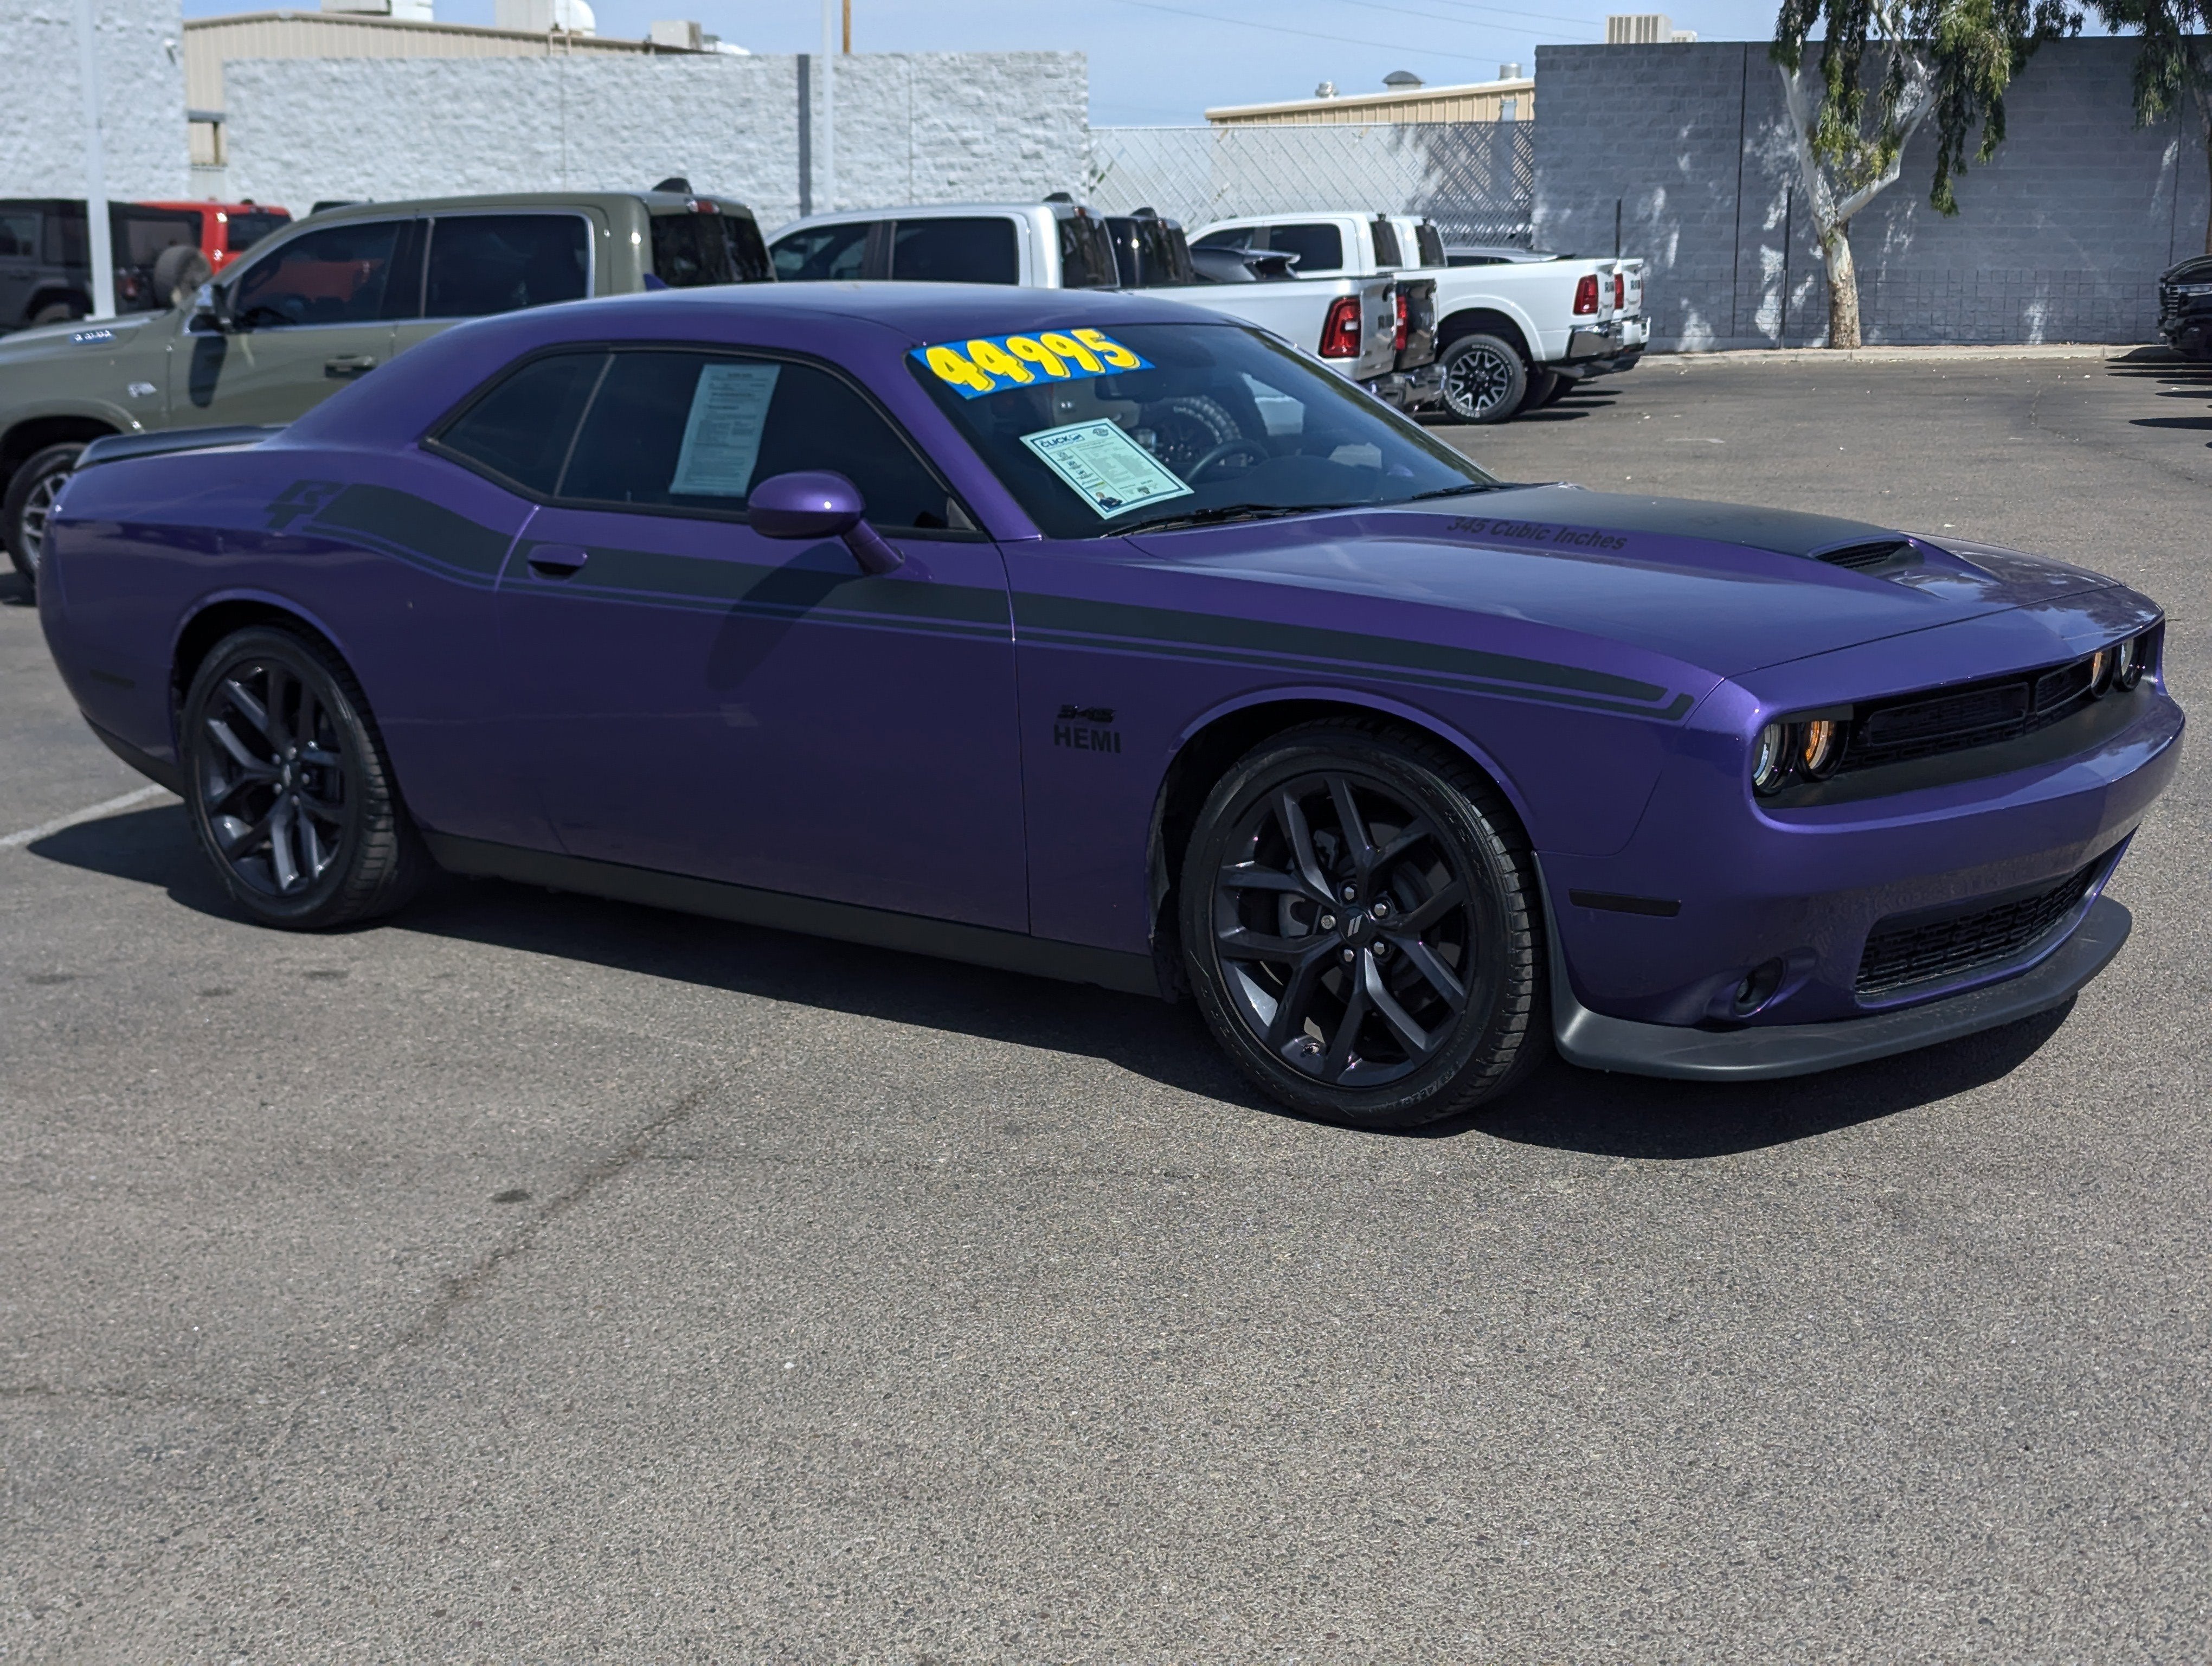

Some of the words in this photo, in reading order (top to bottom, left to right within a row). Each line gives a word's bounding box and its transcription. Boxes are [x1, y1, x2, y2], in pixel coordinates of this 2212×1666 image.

[926, 328, 1141, 391] 44995
[1446, 515, 1491, 534] 345
[1490, 520, 1550, 541] Cubic
[1553, 527, 1627, 550] Inches
[1053, 725, 1121, 753] HEMI
